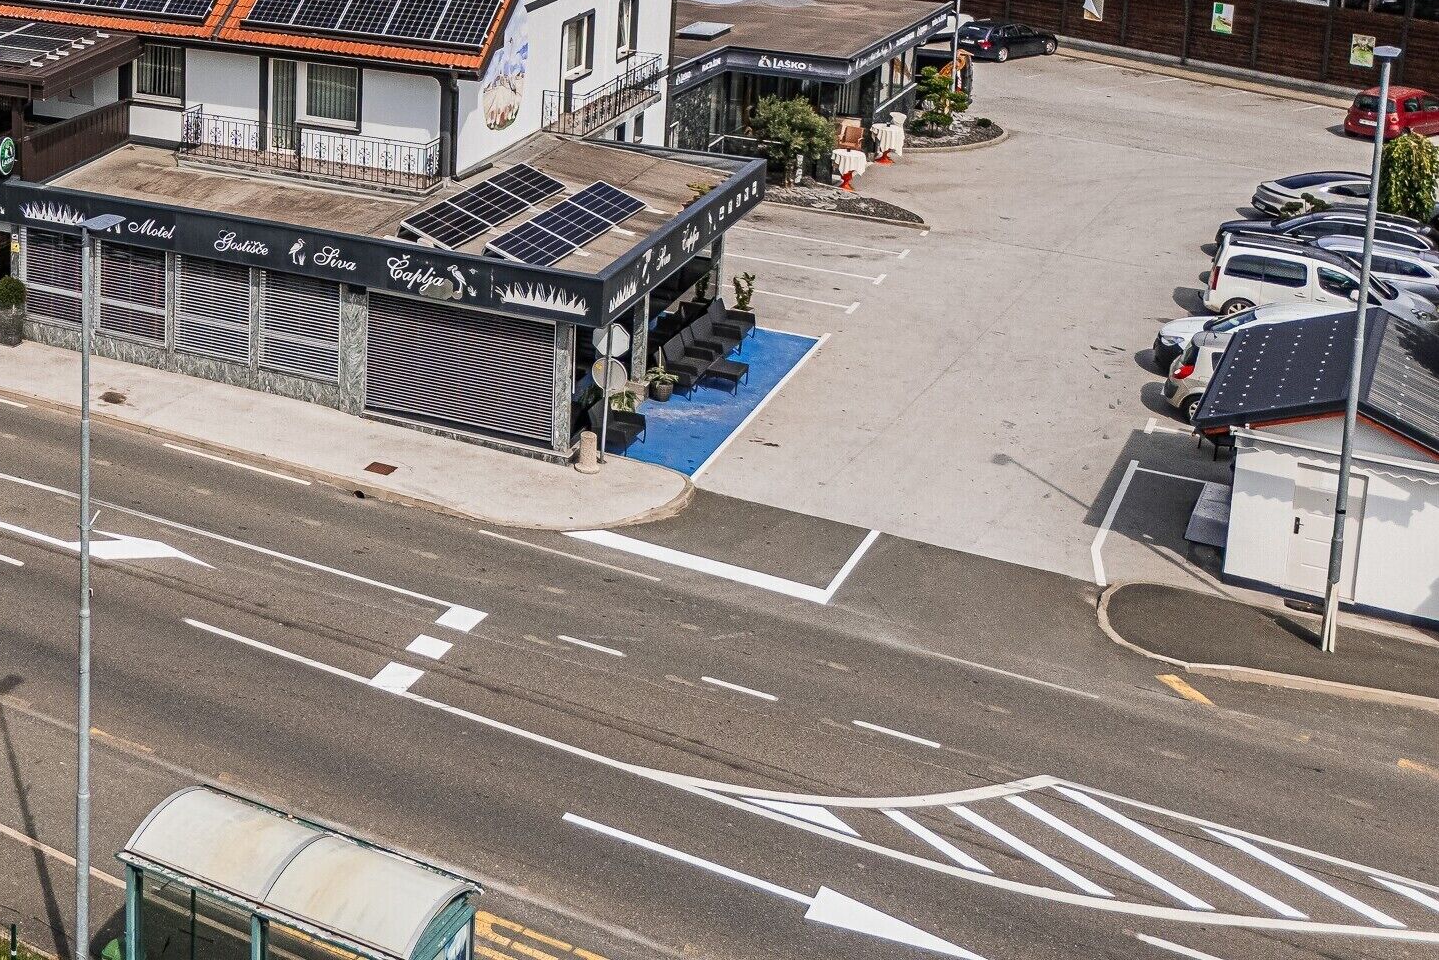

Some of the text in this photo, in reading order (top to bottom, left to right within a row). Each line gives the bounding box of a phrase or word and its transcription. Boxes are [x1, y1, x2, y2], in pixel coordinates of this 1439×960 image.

[772, 58, 807, 70] LAŠKO
[127, 218, 446, 292] Motel Gostišče Siva Čaplja
